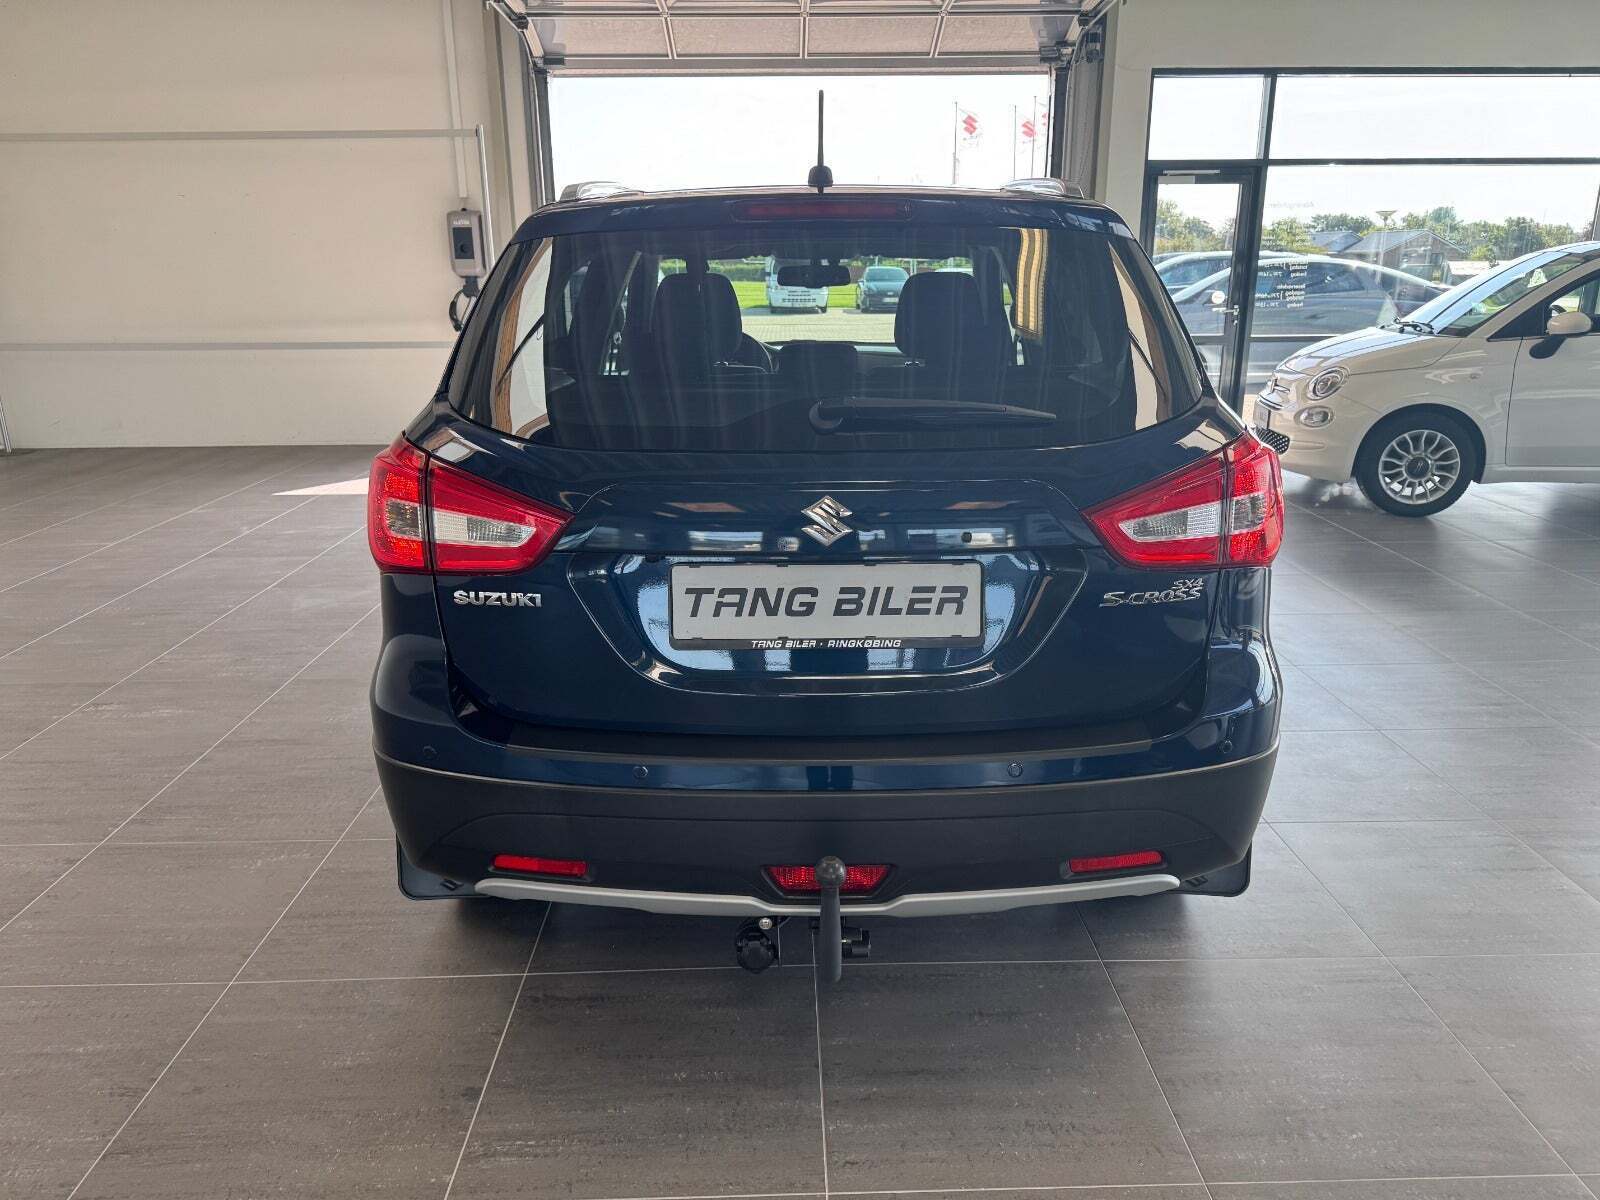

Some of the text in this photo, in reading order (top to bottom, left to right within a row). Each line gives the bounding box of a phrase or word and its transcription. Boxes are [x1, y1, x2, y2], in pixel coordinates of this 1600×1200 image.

[1173, 578, 1204, 588] SX4
[453, 590, 542, 608] SUZUKI
[684, 586, 968, 617] TANG BILER
[751, 639, 902, 648] TANG BILER RINGKØBING
